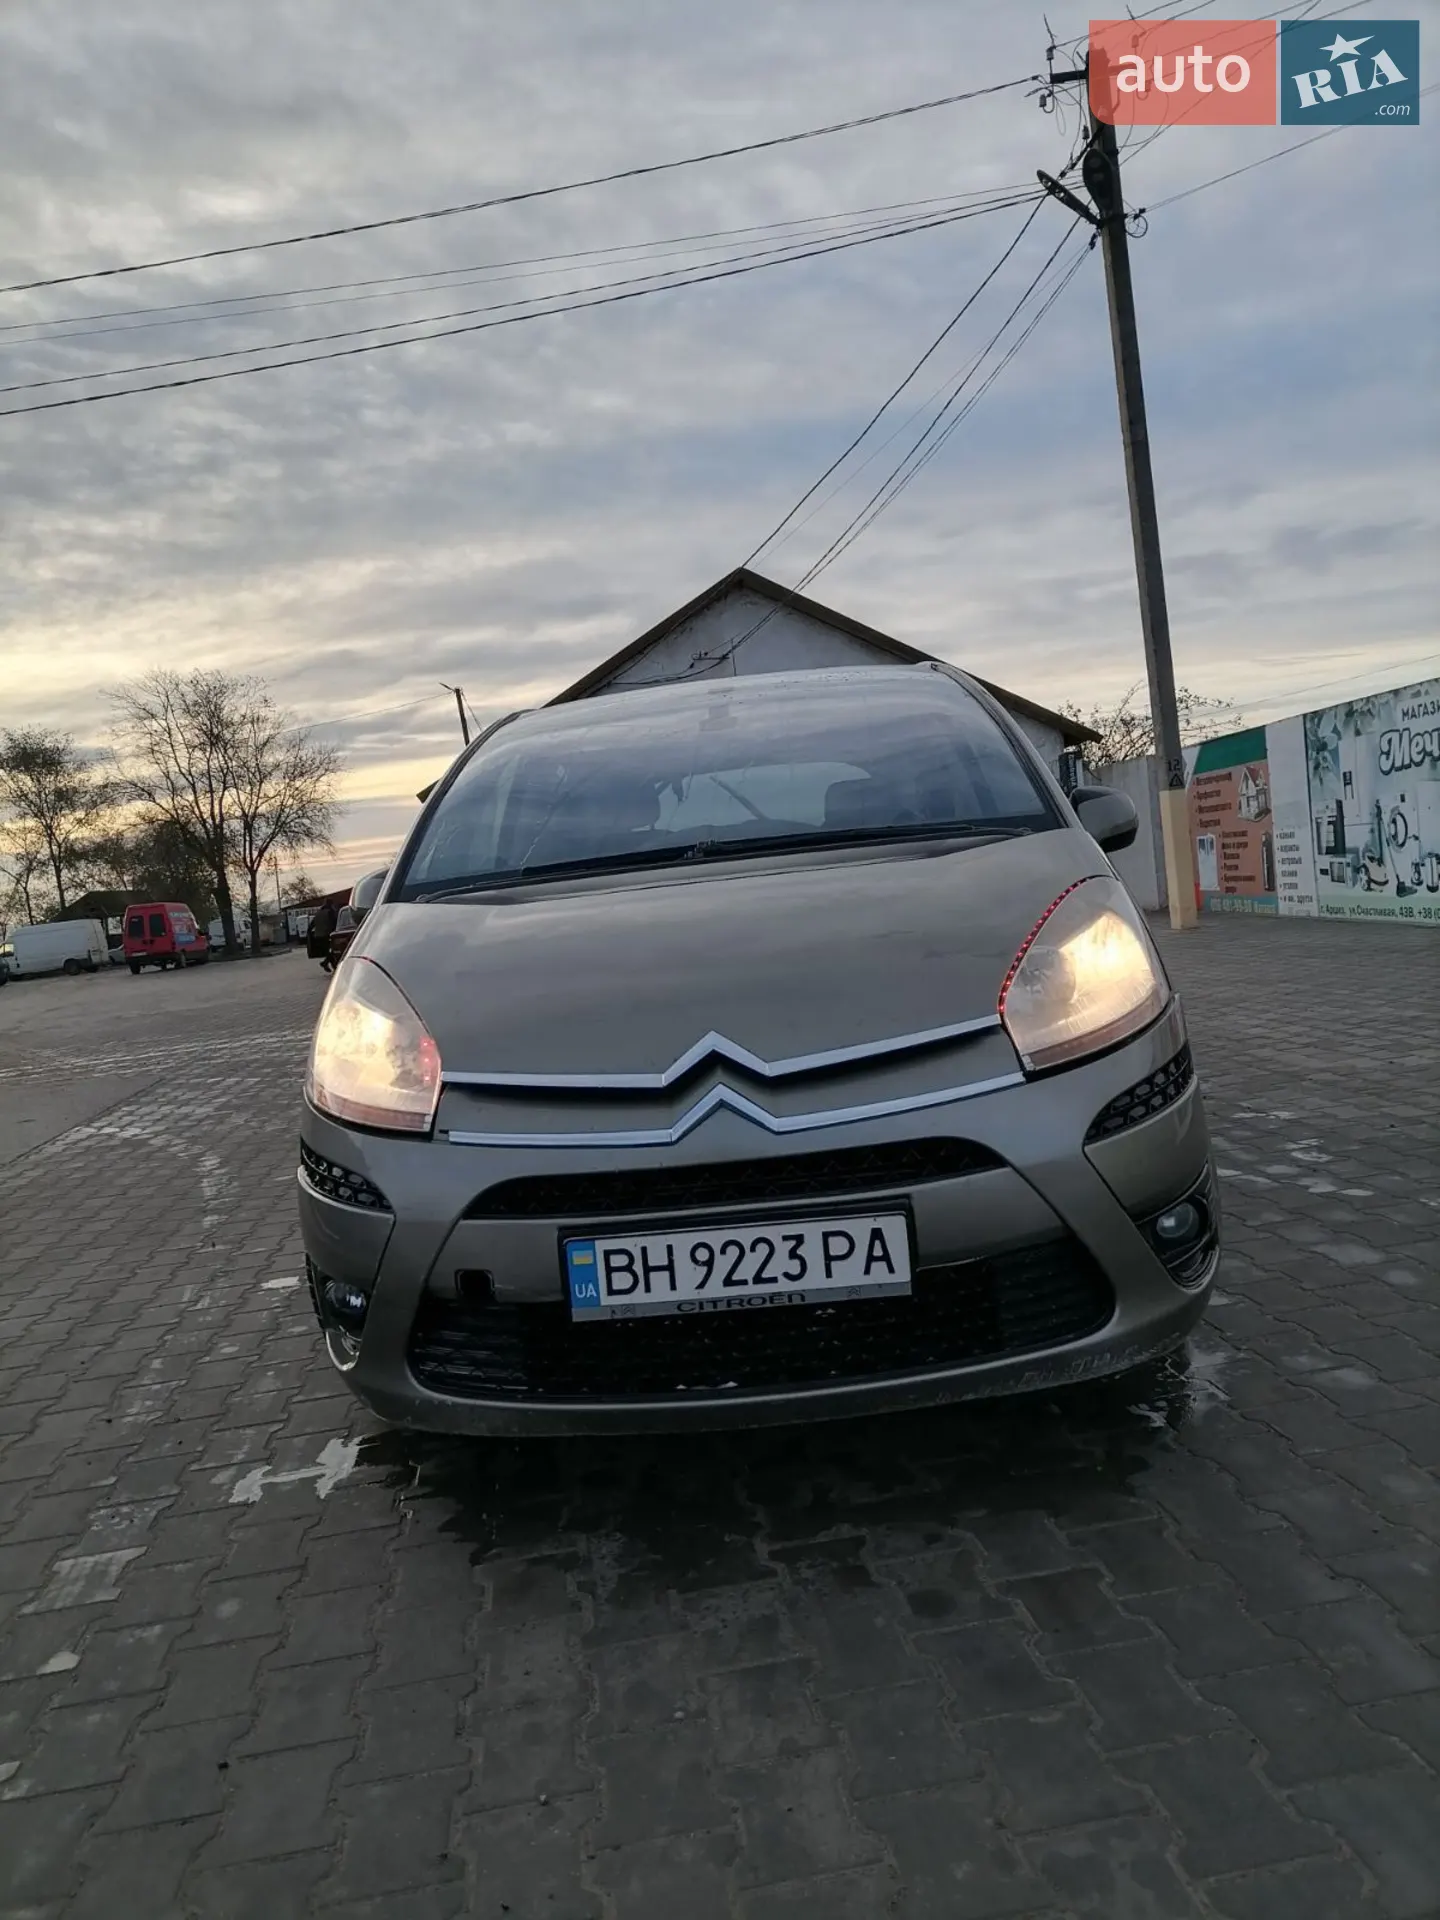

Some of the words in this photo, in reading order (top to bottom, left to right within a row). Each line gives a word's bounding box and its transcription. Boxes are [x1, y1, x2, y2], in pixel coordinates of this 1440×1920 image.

[1418, 907, 1433, 919] +38
[603, 1244, 677, 1296] BH
[689, 1234, 807, 1290] 9223
[821, 1228, 896, 1279] PA
[575, 1284, 597, 1298] UA
